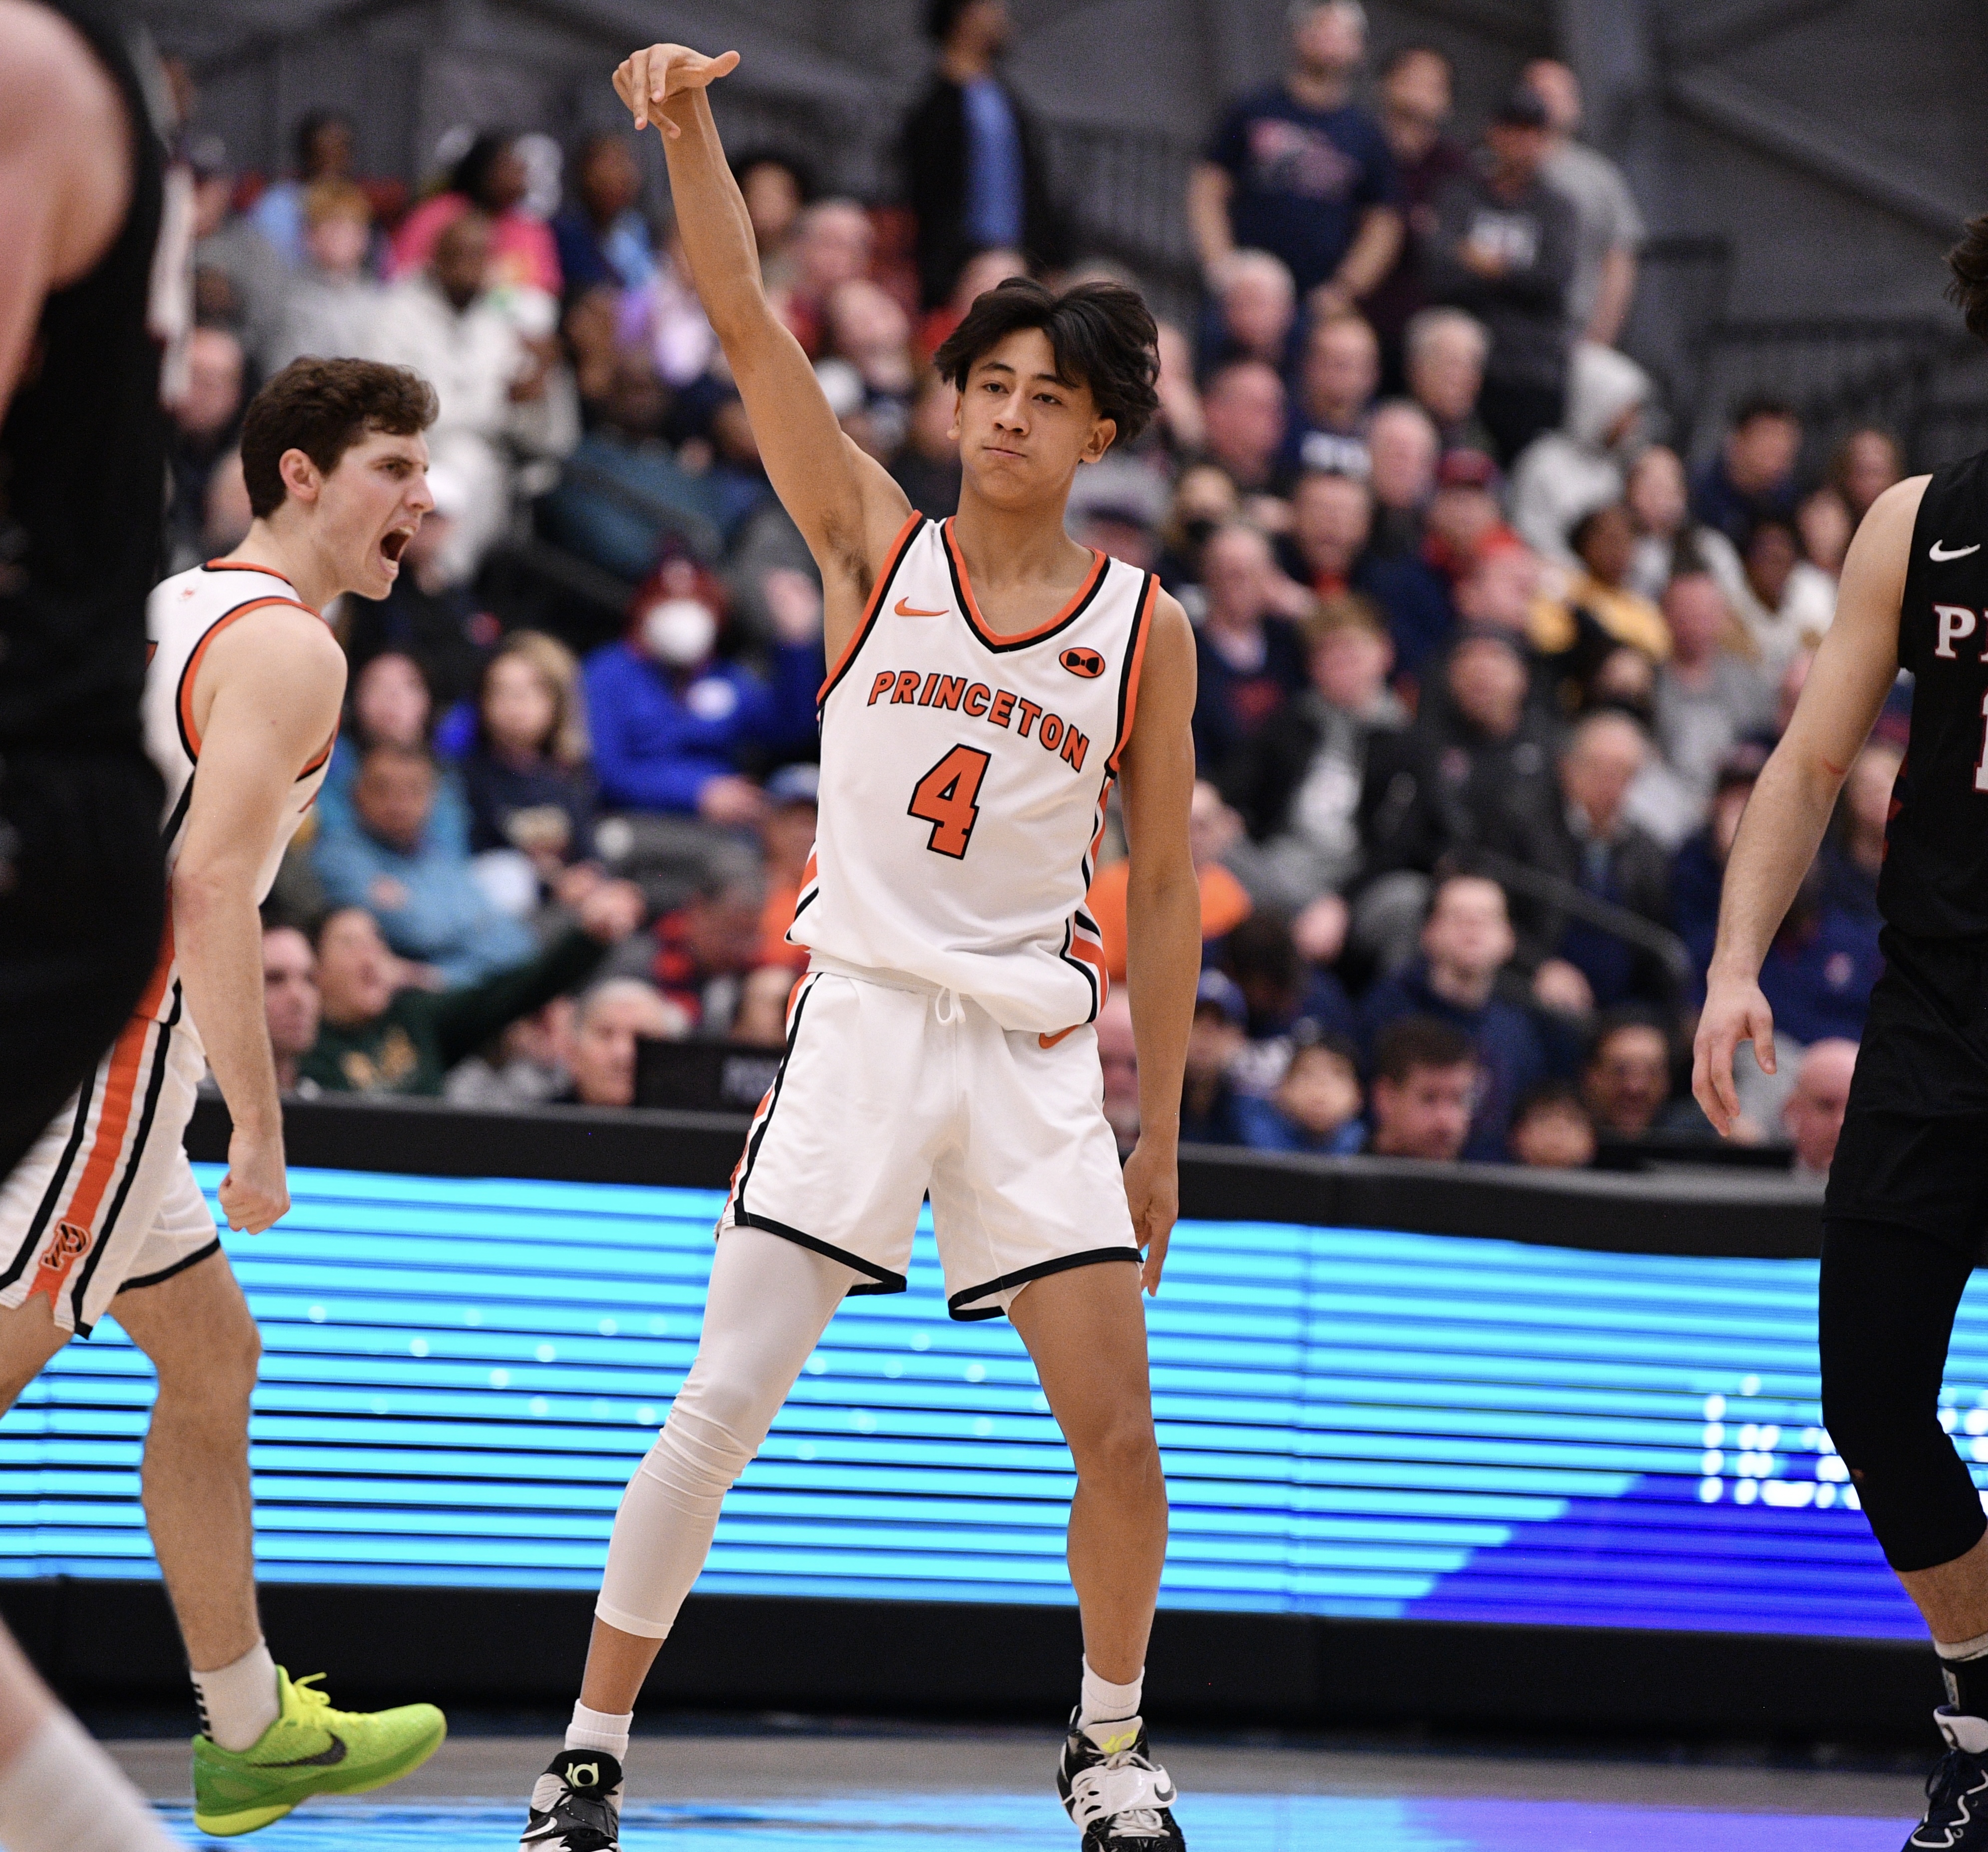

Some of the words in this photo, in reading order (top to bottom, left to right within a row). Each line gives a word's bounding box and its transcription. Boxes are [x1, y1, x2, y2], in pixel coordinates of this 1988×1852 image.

[1933, 602, 1988, 662] P
[867, 670, 1090, 773] PRINCETON
[907, 743, 992, 860] 4
